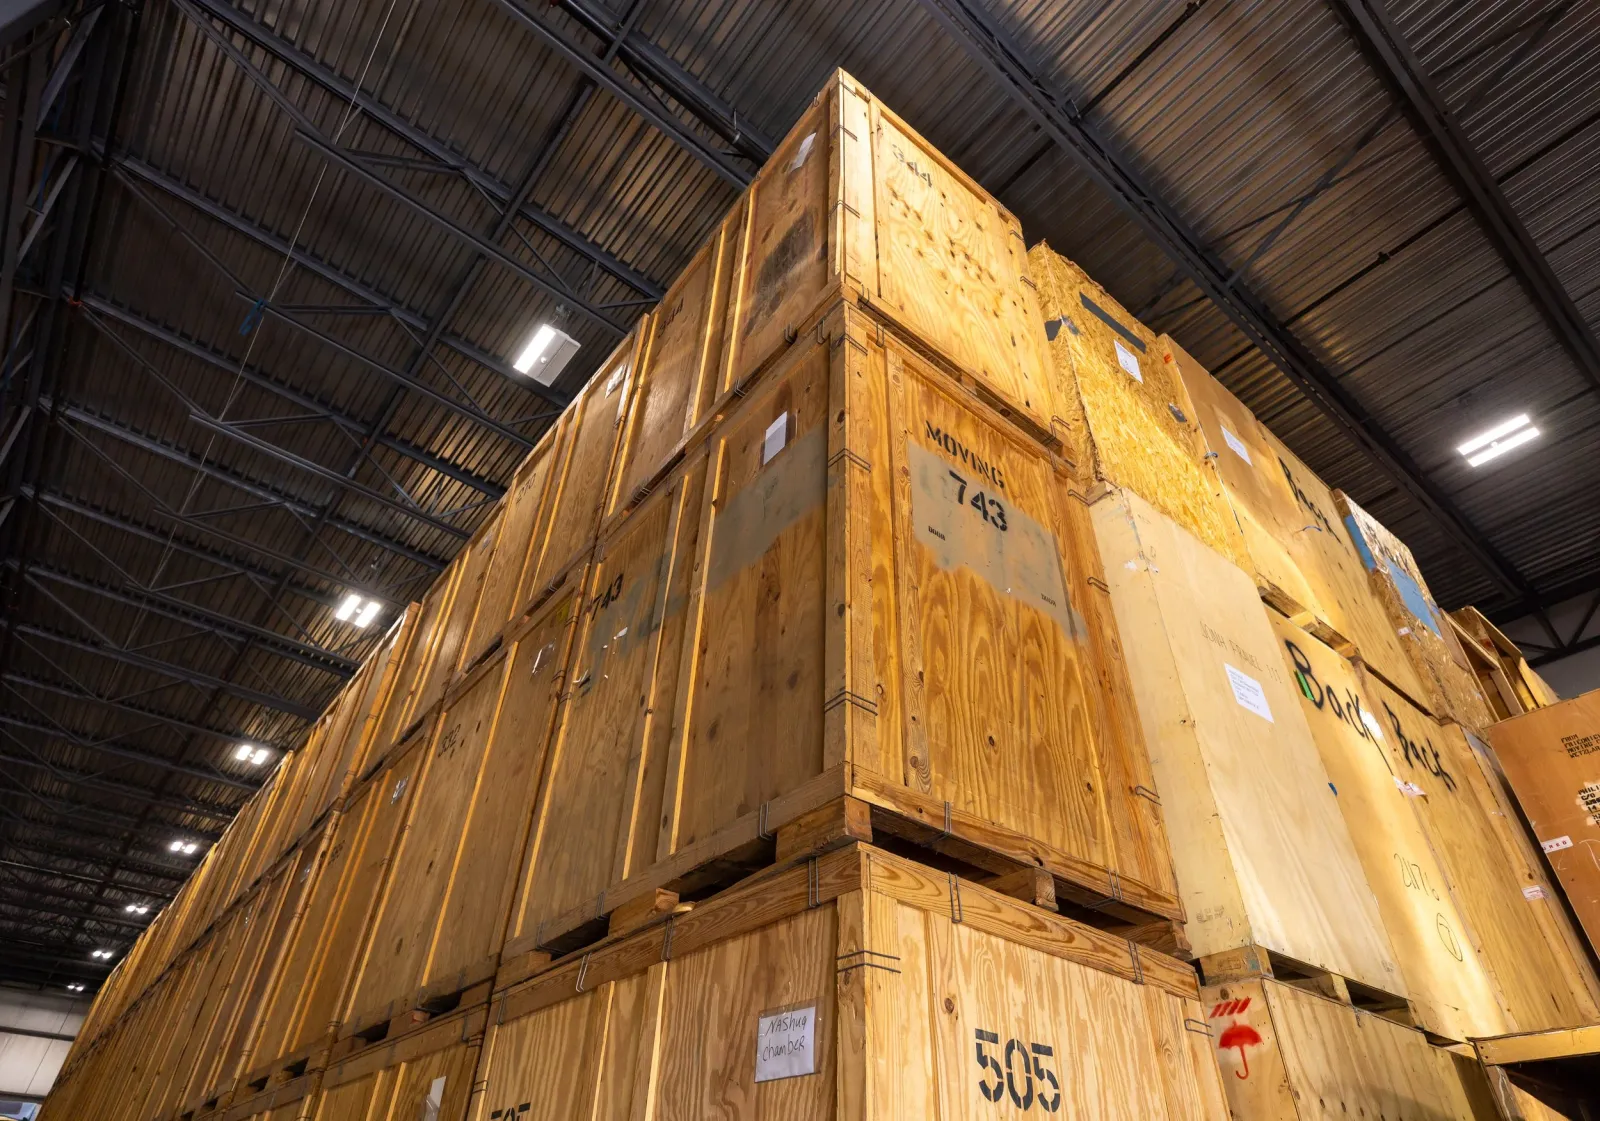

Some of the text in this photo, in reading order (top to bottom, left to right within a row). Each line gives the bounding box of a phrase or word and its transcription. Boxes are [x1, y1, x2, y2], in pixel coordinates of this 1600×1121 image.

[925, 420, 1005, 489] MOVING
[948, 469, 1008, 532] 743
[1283, 638, 1392, 776] Back
[1560, 733, 1579, 744] FROM
[974, 1027, 1061, 1113] 505
